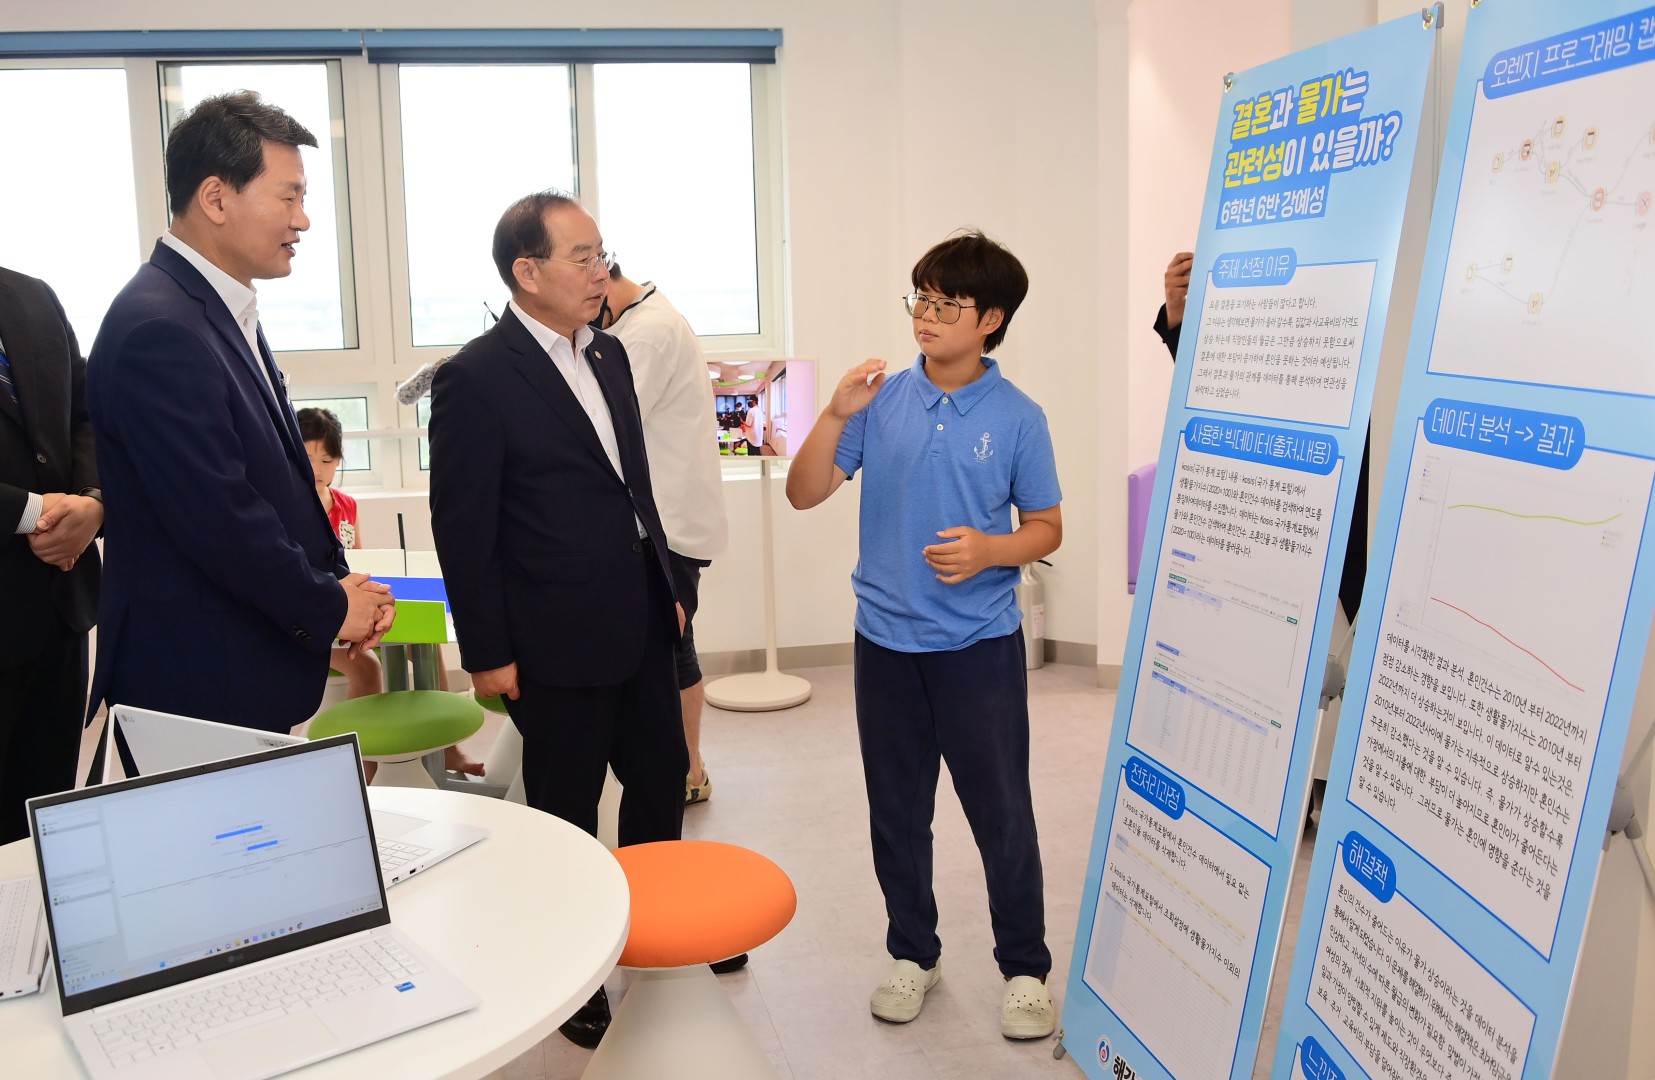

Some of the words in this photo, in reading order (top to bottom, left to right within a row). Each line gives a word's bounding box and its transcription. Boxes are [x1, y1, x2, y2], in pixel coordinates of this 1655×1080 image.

[1490, 50, 1540, 88] 오렌지
[1541, 22, 1634, 75] 프로그래밍
[1231, 89, 1293, 140] 결혼과
[1297, 72, 1367, 124] 물가는
[1224, 136, 1307, 188] 관련성이
[1310, 115, 1400, 169] 있을까?
[1220, 196, 1256, 225] 6학년
[1256, 192, 1280, 220] 6반
[1281, 185, 1326, 218] 강예성
[1218, 259, 1240, 280] 주제
[1241, 257, 1264, 278] 선정
[1265, 255, 1290, 277] 이유
[1190, 423, 1224, 447] 사용한
[1225, 428, 1332, 465] 빅데이터(출처,내용)
[1431, 407, 1476, 439] 데이터
[1479, 414, 1511, 445] 분석
[1537, 423, 1575, 458] 결과
[1377, 673, 1410, 700] 2022년까지
[1410, 691, 1417, 704] 더
[1486, 734, 1494, 749] 이
[1494, 739, 1522, 765] 데이터로
[1382, 652, 1394, 669] 점점
[1395, 659, 1419, 682] 감소하는
[1420, 672, 1439, 693] 경향을
[1468, 698, 1484, 717] 또한
[1485, 706, 1536, 746] 생활물가지수는
[1537, 735, 1564, 762] 2010년
[1564, 751, 1582, 772] 부터
[1386, 632, 1410, 654] 데이터를
[1410, 643, 1436, 666] 시각화한
[1436, 655, 1449, 672] 결과
[1466, 670, 1501, 700] 혼인건수는
[1502, 689, 1527, 714] 2010년
[1527, 702, 1544, 722] 부터
[1544, 710, 1587, 745] 2022년까지
[1131, 762, 1180, 811] 전처리과정
[1365, 782, 1372, 793] 수
[1422, 746, 1435, 765] 것을
[1436, 755, 1444, 770] 알
[1444, 762, 1452, 775] 수
[1497, 794, 1521, 821] 물가가
[1522, 812, 1563, 850] 상승할수록
[1443, 734, 1464, 758] 물가는
[1465, 748, 1499, 778] 지속적으로
[1500, 769, 1538, 804] 상승하지만
[1538, 792, 1570, 825] 혼인수는
[1382, 769, 1389, 781] 수
[1444, 811, 1464, 837] 물가는
[1465, 827, 1487, 853] 혼인에
[1487, 842, 1509, 870] 영향을
[1510, 859, 1534, 888] 준다는
[1535, 878, 1551, 901] 것을
[1413, 766, 1426, 784] 대한
[1427, 775, 1448, 798] 부담이
[1448, 789, 1455, 804] 더
[1520, 837, 1558, 877] 줄어든다는
[1349, 839, 1389, 891] 해결책
[1305, 1044, 1338, 1080] 느낀
